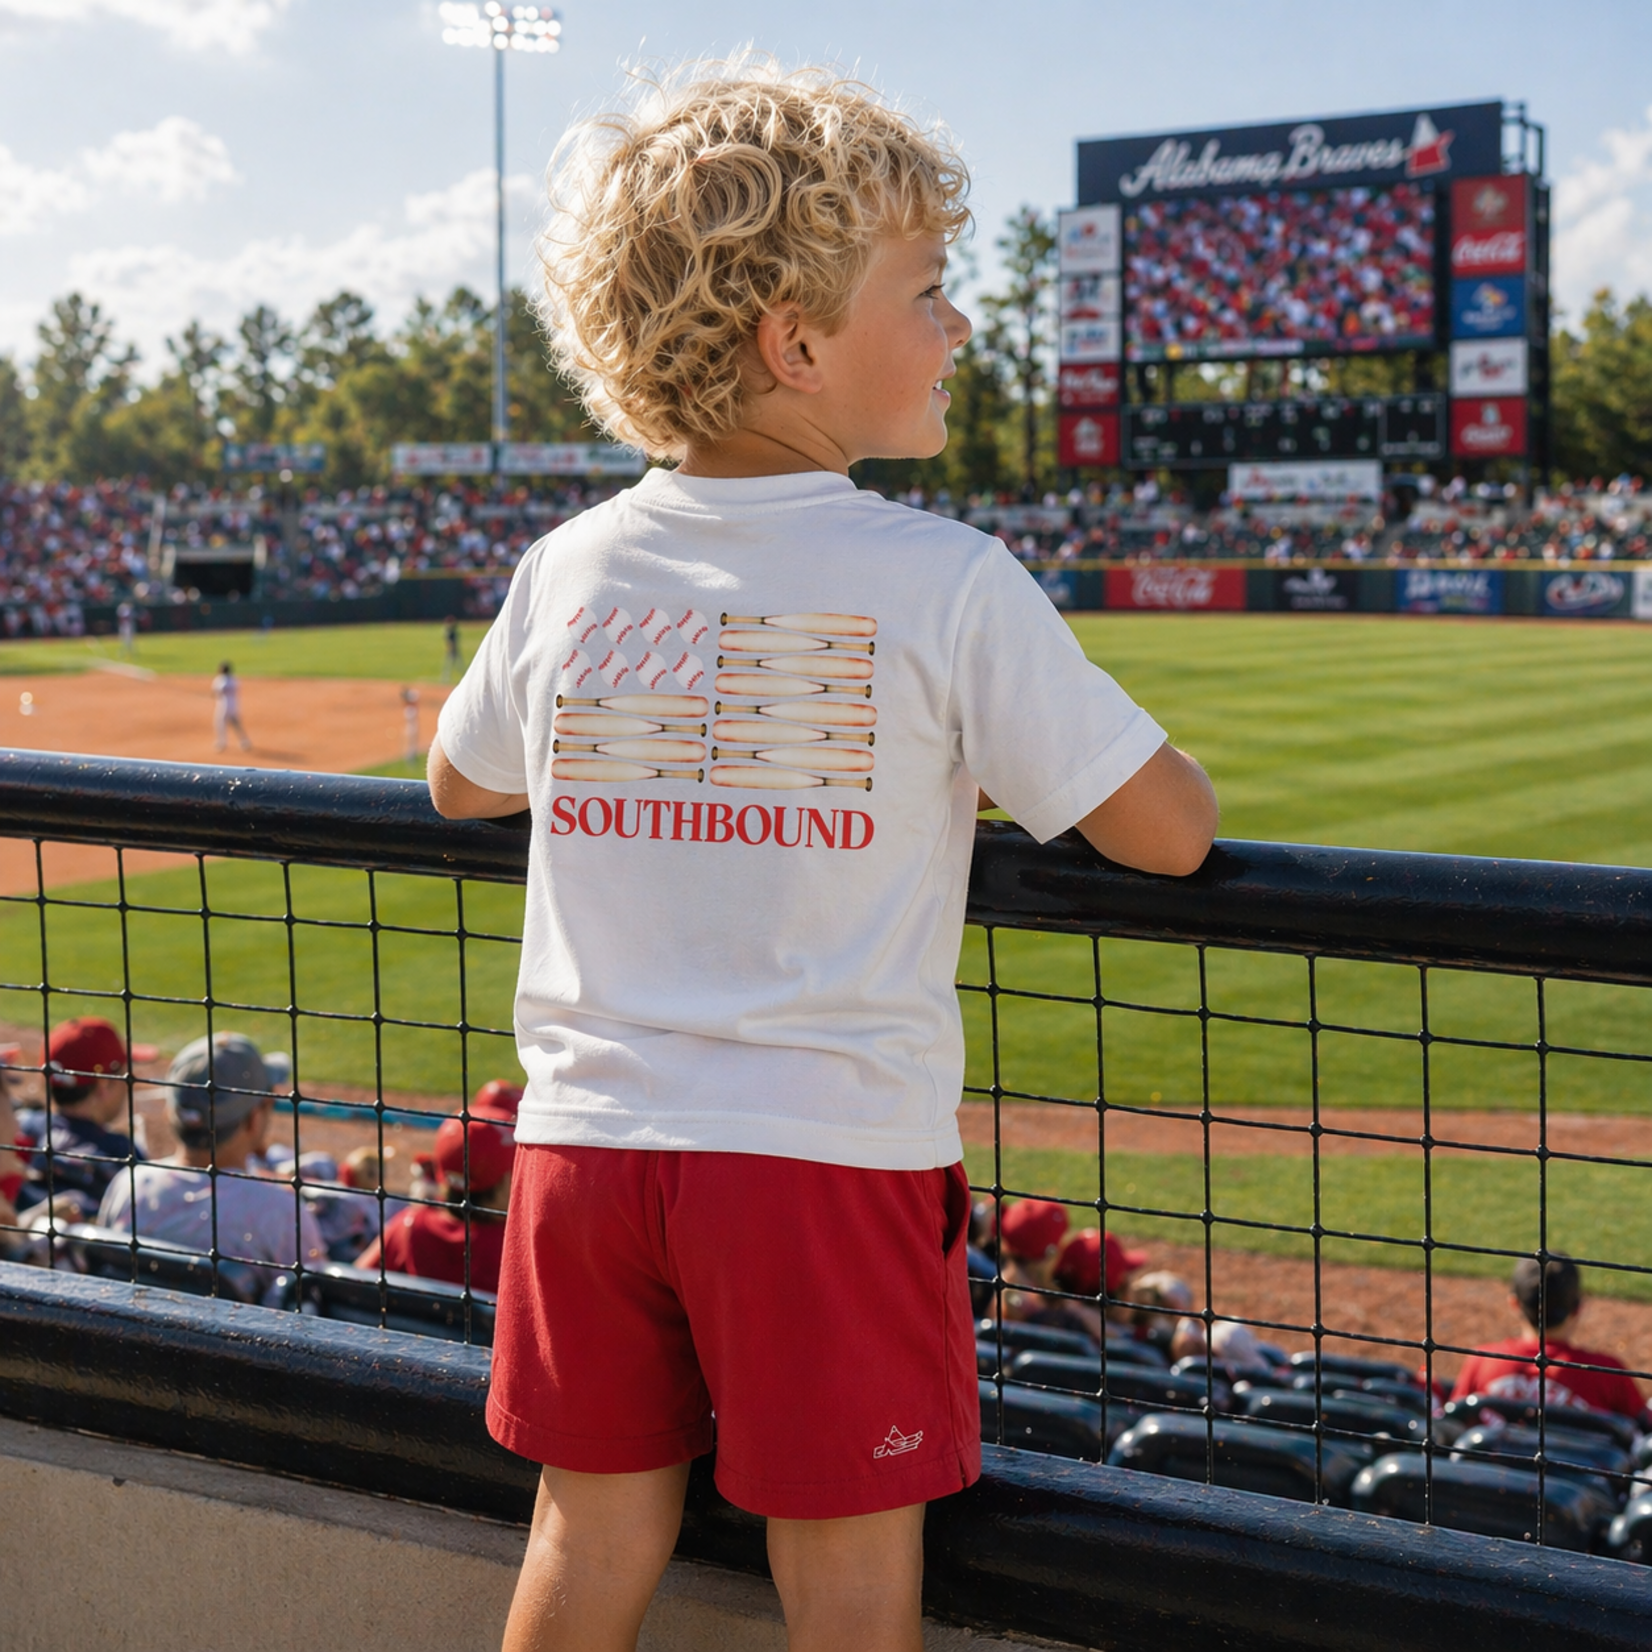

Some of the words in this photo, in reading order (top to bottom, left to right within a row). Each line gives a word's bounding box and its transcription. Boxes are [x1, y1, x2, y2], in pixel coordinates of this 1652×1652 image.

[1118, 137, 1284, 198] Alabama
[1285, 123, 1404, 181] Braves
[550, 795, 875, 850] SOUTHBOUND
